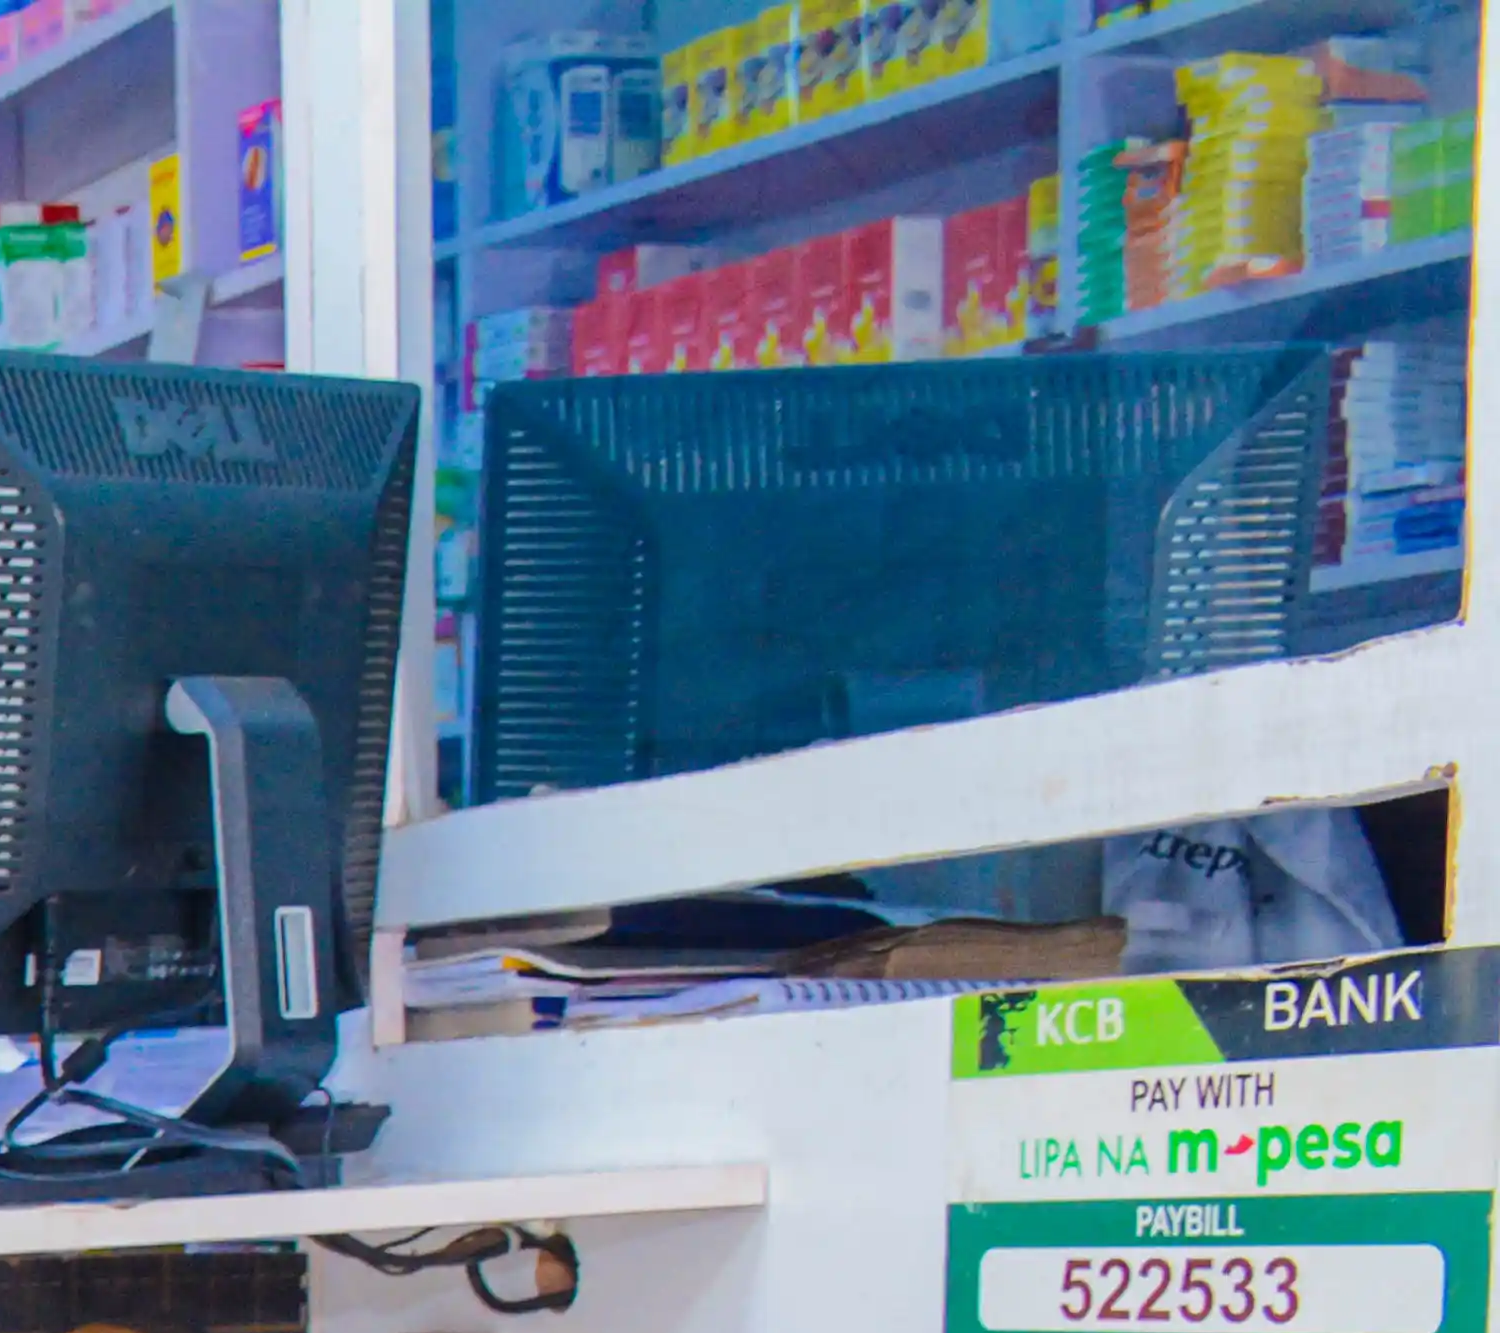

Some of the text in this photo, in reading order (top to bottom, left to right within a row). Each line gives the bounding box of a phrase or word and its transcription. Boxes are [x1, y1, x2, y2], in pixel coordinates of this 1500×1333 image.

[1035, 997, 1126, 1047] KCB
[1262, 970, 1424, 1034] BANK
[1129, 1072, 1277, 1113] PAY WITH
[1018, 1138, 1083, 1182] LIPA
[1096, 1136, 1152, 1178] NA
[1135, 1204, 1246, 1239] PAYBILL
[1058, 1258, 1302, 1324] 522533
